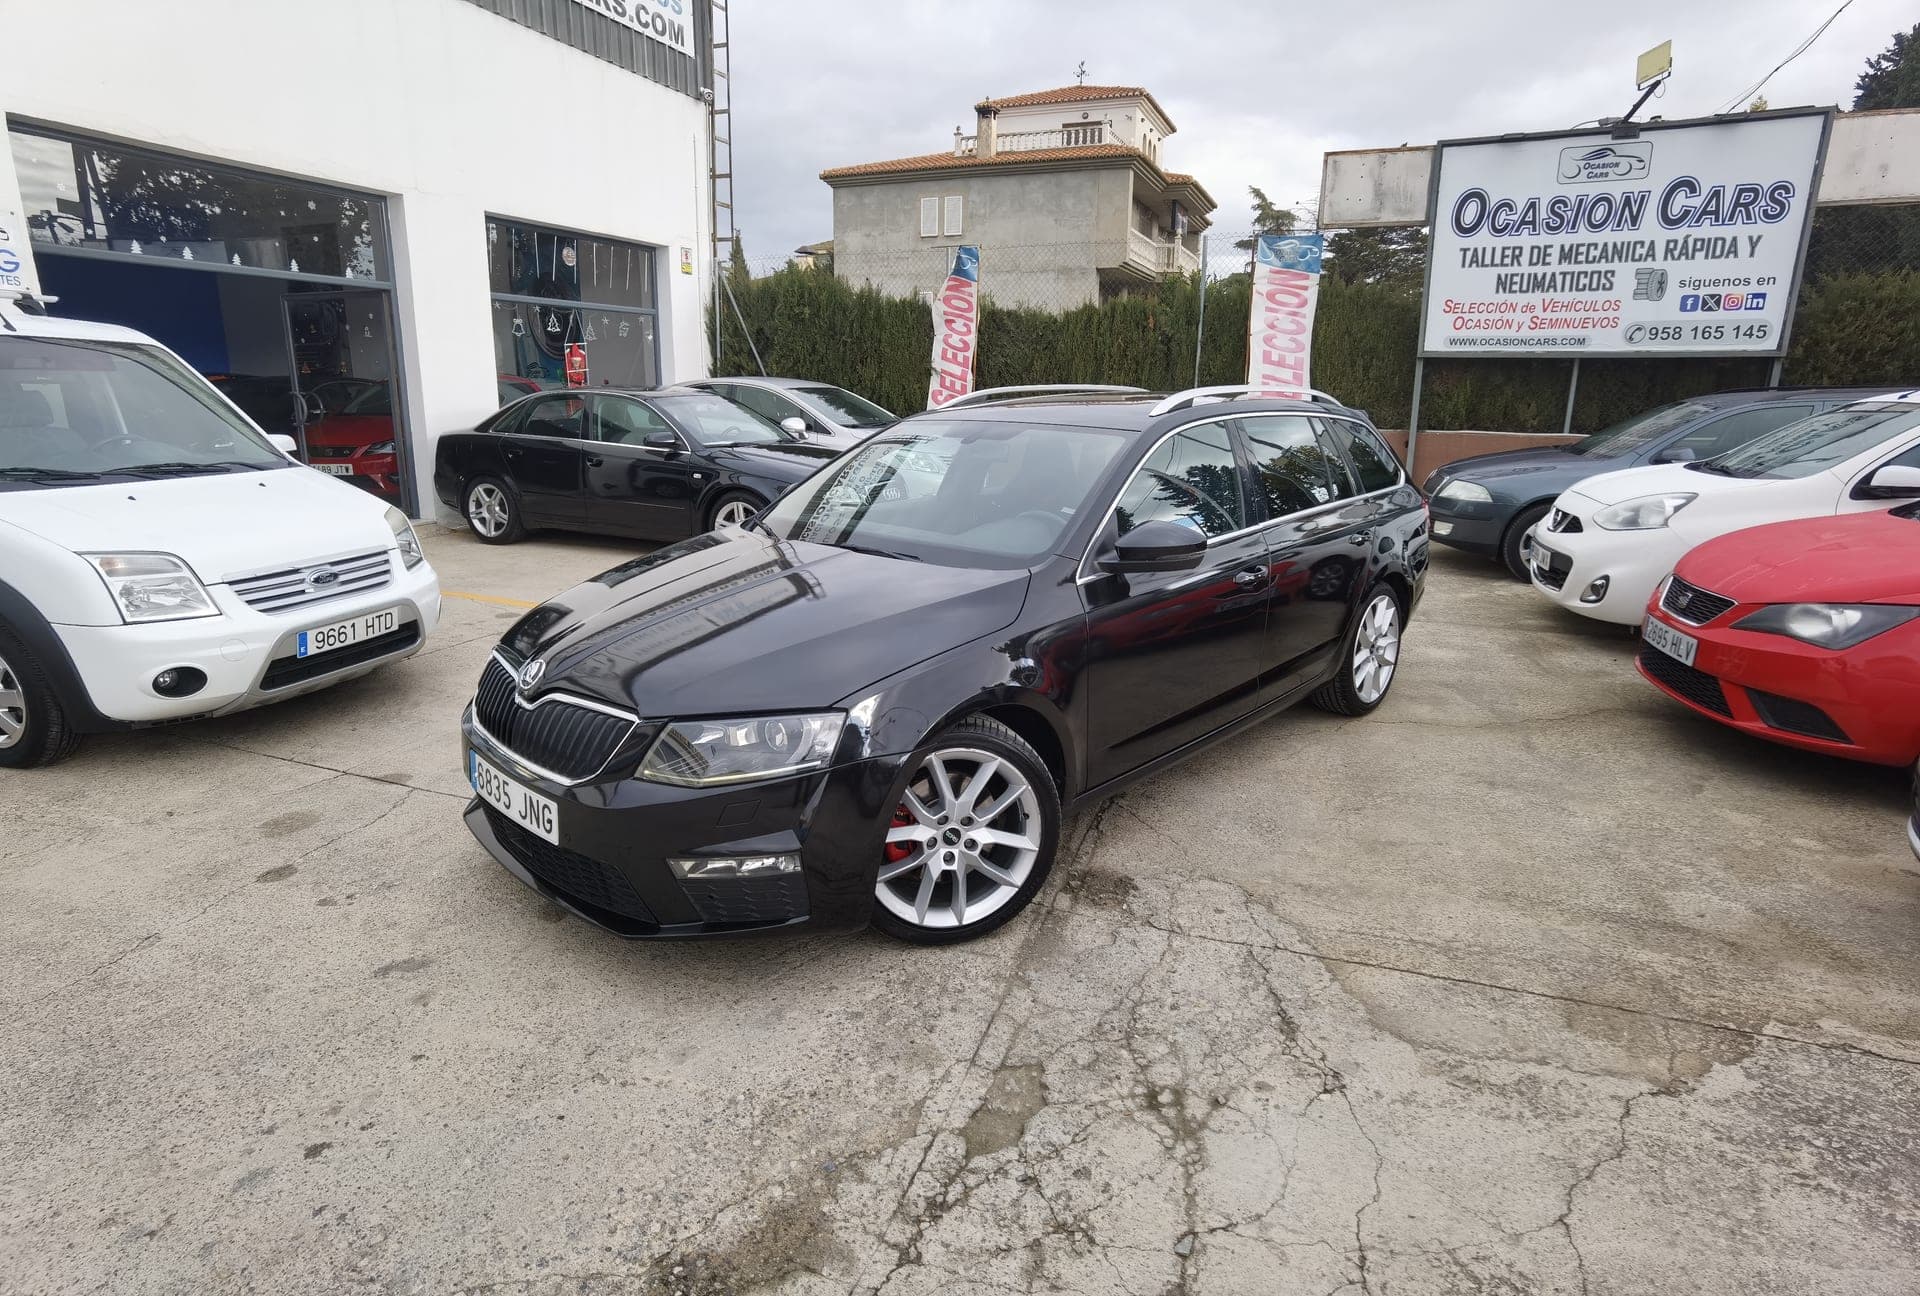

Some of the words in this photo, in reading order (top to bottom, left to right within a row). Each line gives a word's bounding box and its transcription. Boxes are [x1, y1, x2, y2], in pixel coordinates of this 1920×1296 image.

[1583, 162, 1620, 170] OCASION
[1586, 171, 1609, 179] CARS
[1451, 188, 1651, 238] OCASION
[1657, 176, 1795, 230] CARS
[1460, 246, 1523, 268] TALLER
[1528, 244, 1554, 267] DE
[1557, 239, 1657, 266] MECANICA
[1663, 234, 1739, 261] RÁPIDA
[1748, 235, 1763, 259] Y
[1495, 270, 1616, 294] NEUMATICOS
[1756, 275, 1777, 287] en
[1443, 299, 1518, 314] SELECCIÓN
[1520, 302, 1536, 314] de
[1542, 298, 1622, 313] VEHÍCULOS
[1453, 316, 1514, 331] OCASIÓN
[1516, 320, 1525, 332] y
[1528, 315, 1620, 331] SEMINUEVOS
[1648, 326, 1683, 341] 958
[1690, 324, 1725, 340] 165
[1732, 323, 1768, 339] 145
[1449, 337, 1586, 347] WWW.OCASIONCARS.COM
[315, 622, 356, 649] 9661
[365, 612, 393, 637] HTD
[477, 762, 511, 810] 6835
[519, 792, 553, 834] JNG
